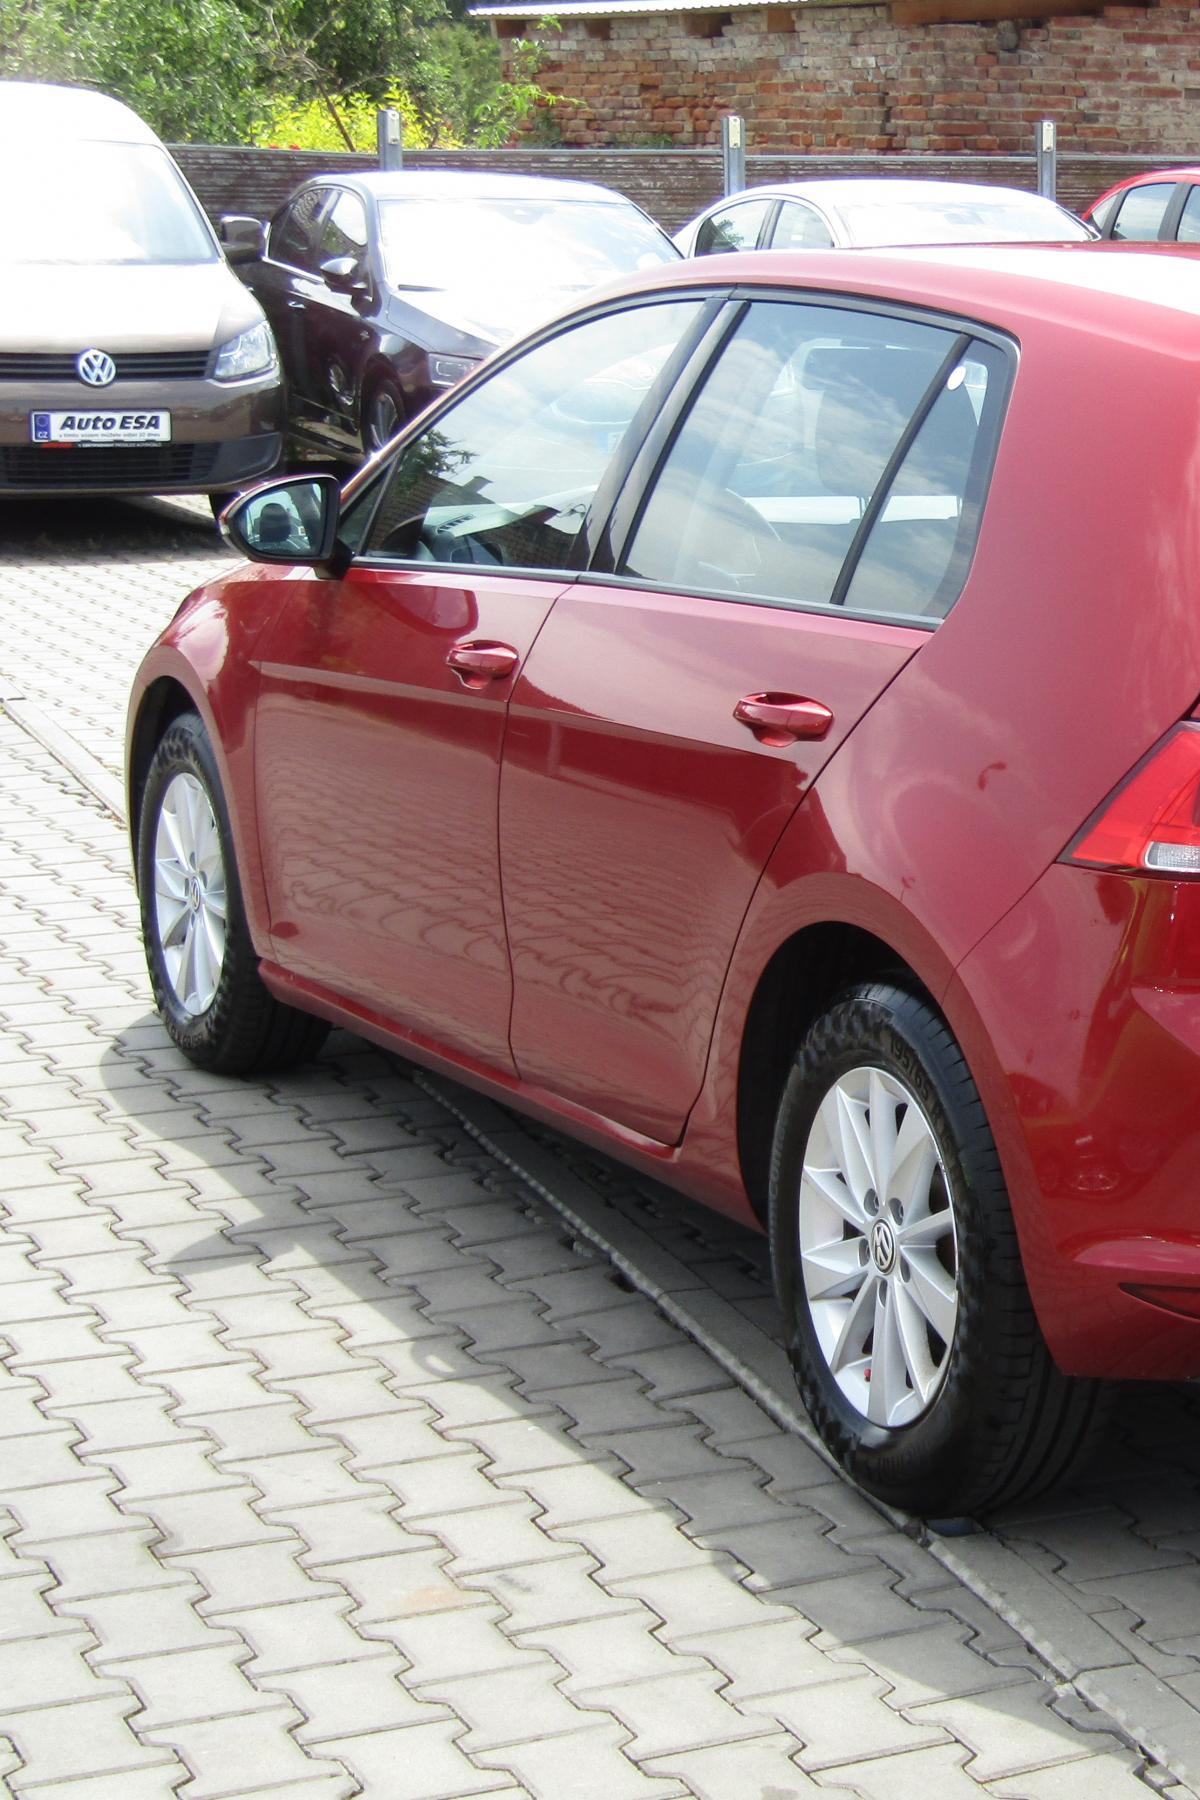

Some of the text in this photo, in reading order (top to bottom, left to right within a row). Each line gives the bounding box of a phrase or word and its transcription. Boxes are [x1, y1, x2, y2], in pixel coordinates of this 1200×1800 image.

[60, 415, 160, 431] Auto ESA
[38, 431, 49, 439] CZ
